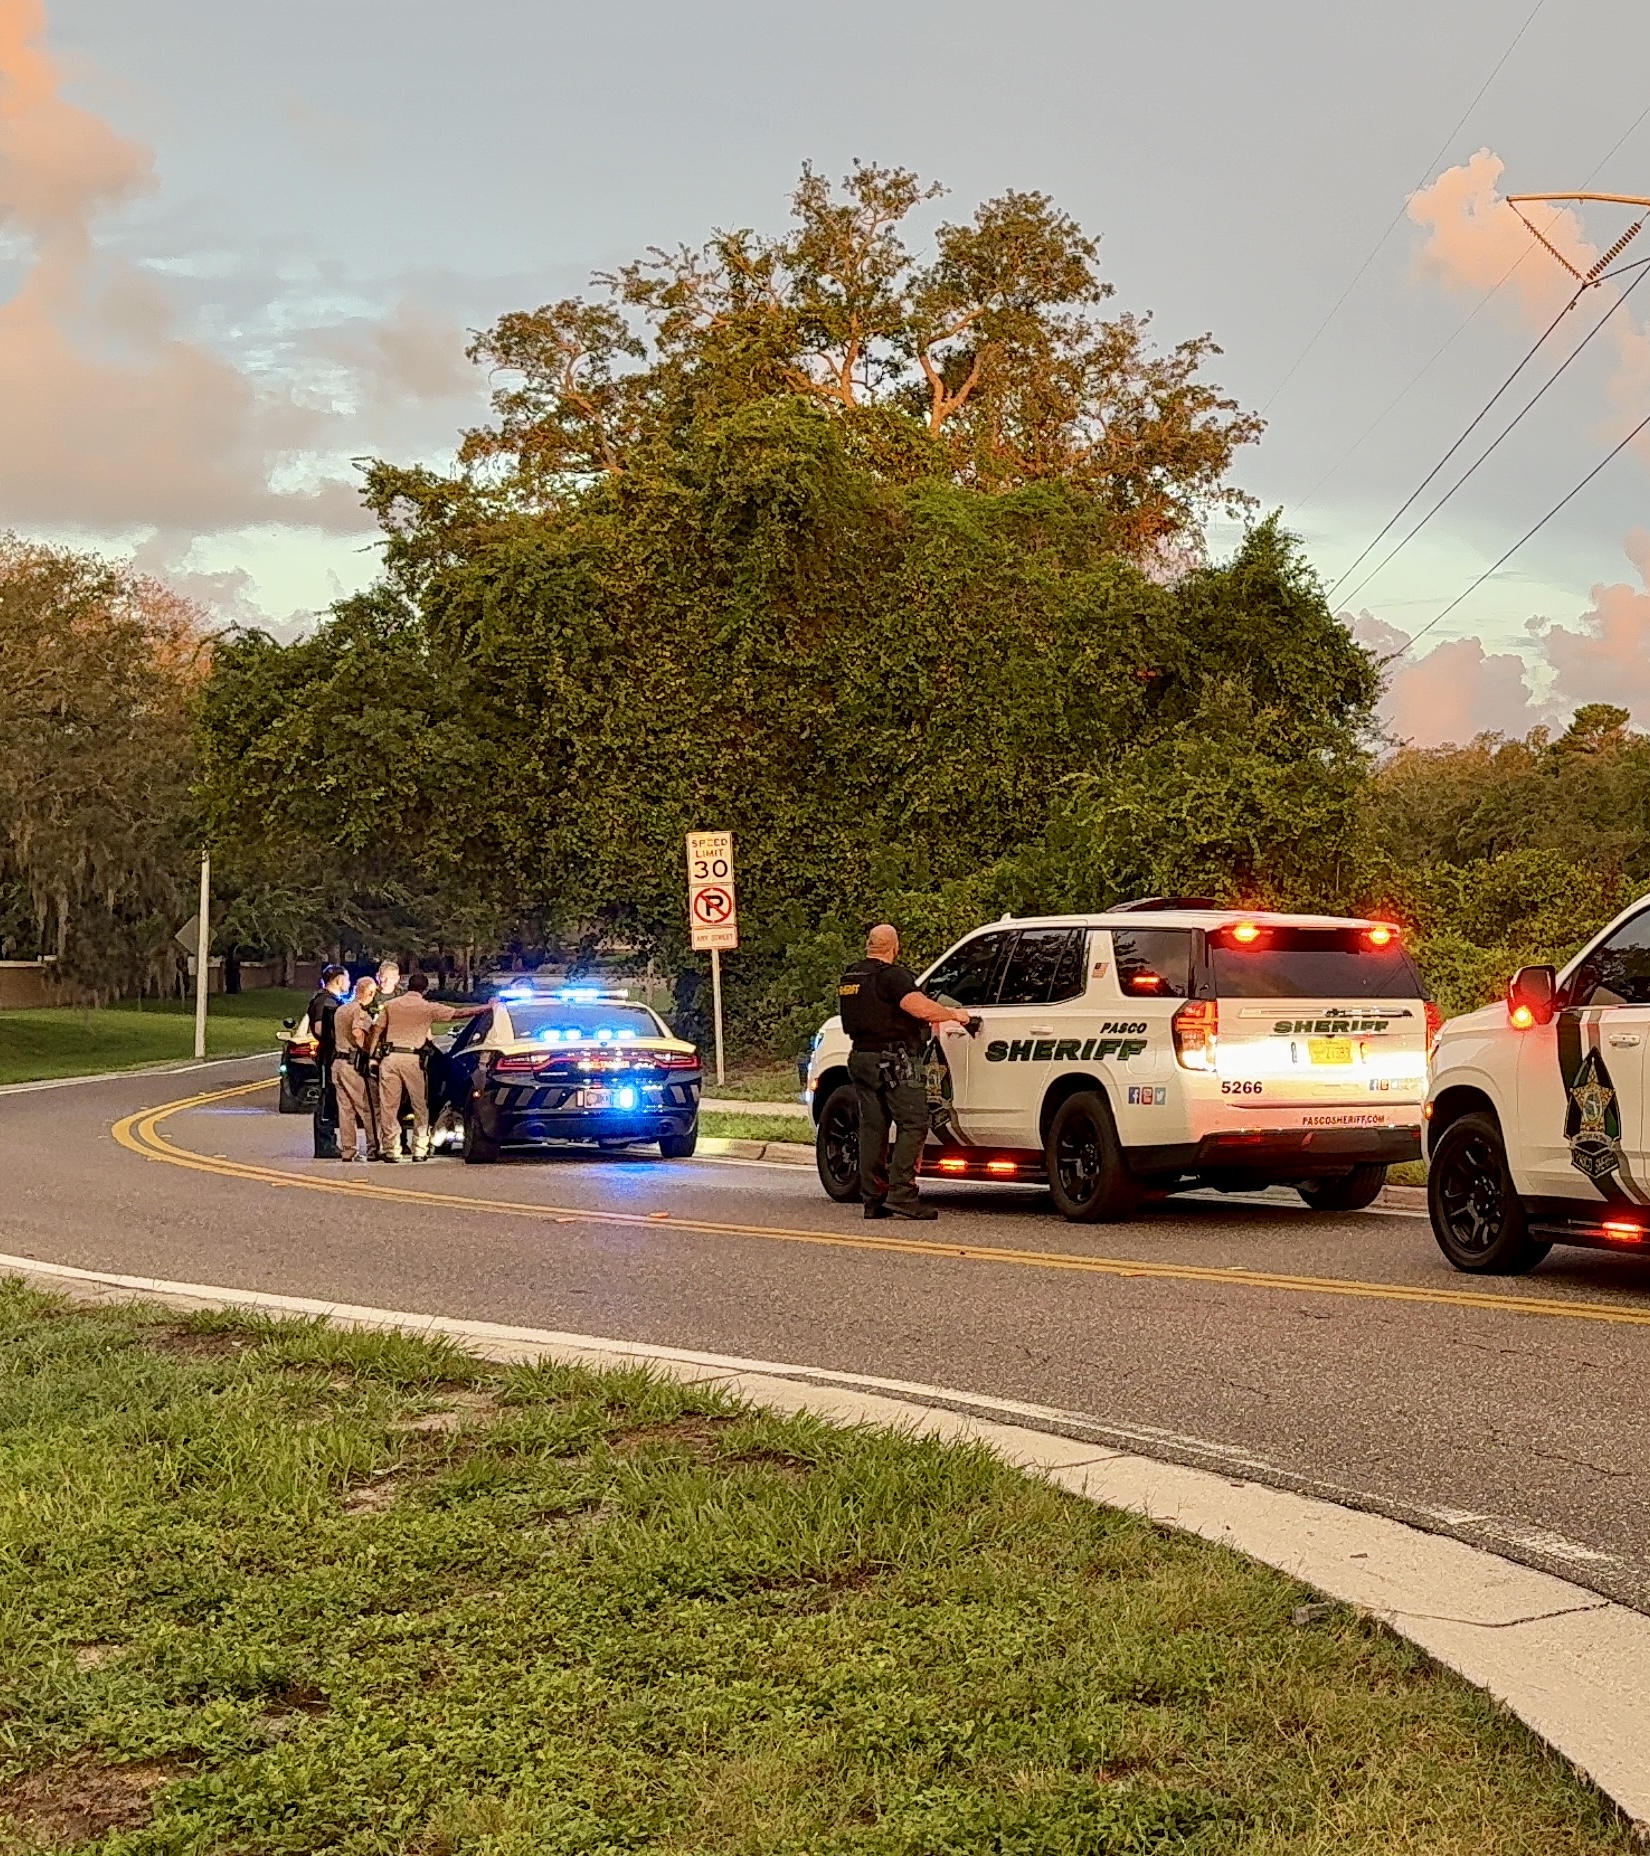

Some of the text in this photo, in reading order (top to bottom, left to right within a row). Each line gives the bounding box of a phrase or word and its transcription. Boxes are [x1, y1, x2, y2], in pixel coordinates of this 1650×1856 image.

[692, 838, 728, 848] SPEED
[696, 849, 724, 858] LIMIT
[694, 859, 728, 879] 30
[1100, 1022, 1147, 1034] PASCO
[1273, 1020, 1389, 1033] SHERIFF
[984, 1038, 1148, 1061] SHERIFF
[1220, 1081, 1263, 1094] 5266
[1301, 1114, 1385, 1126] PASCOSHERIFF.COM
